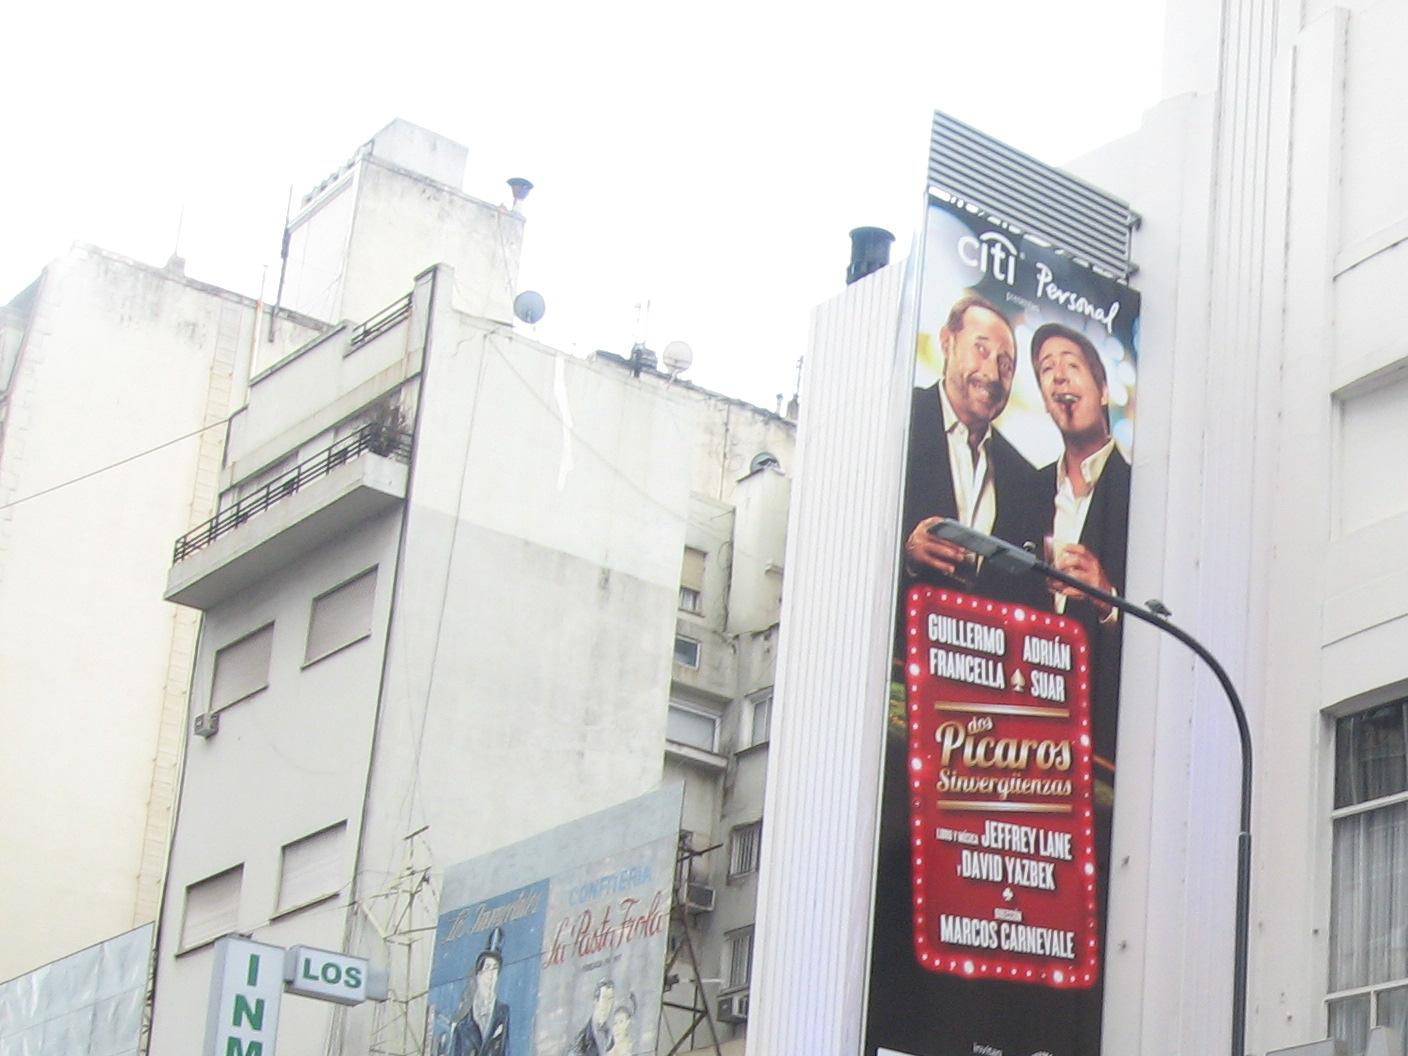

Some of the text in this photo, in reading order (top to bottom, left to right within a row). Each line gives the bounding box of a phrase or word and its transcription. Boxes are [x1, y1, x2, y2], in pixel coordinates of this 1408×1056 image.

[957, 230, 1120, 337] citi Personal
[928, 613, 1071, 671] GUILLERMO ADRIÁN
[929, 648, 1066, 703] FRANCELLA SUAR
[967, 716, 993, 734] dos
[936, 768, 1072, 800] Sinvergüenzas
[981, 819, 1038, 854] JEFFREY
[1038, 828, 1073, 860] LANE
[962, 849, 1002, 882] DAVID
[1004, 855, 1056, 891] YAZBEK
[940, 913, 1076, 960] MARCOS CARNEVALE
[303, 957, 362, 989] LOS
